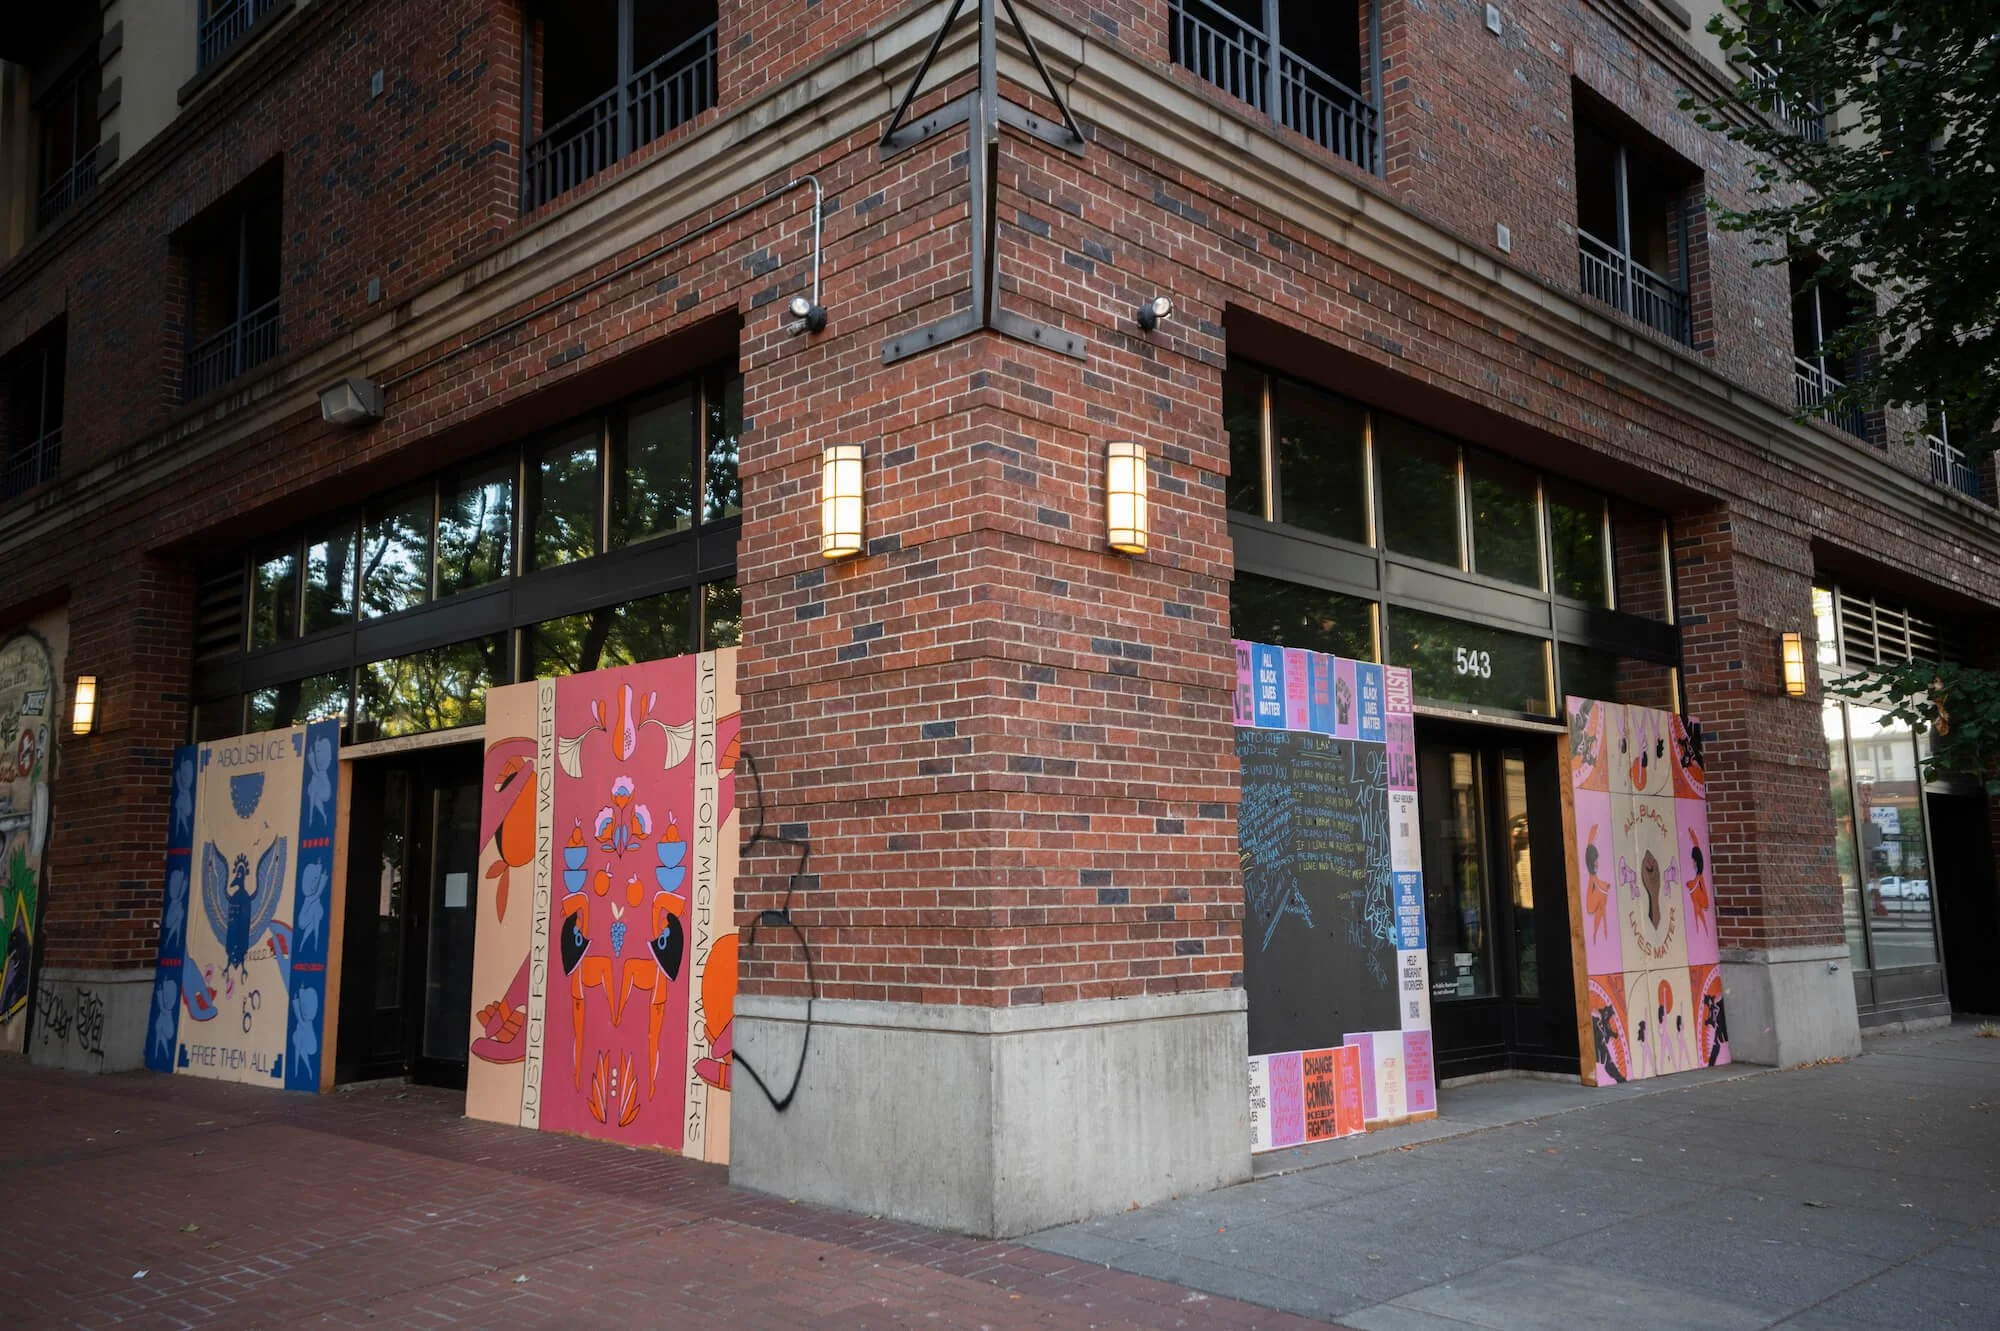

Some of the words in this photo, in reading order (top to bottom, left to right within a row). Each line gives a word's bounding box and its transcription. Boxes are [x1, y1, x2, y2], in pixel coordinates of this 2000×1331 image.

[1263, 653, 1273, 668] ALL
[1457, 647, 1492, 678] 543
[1260, 669, 1277, 684] BLACK
[1365, 671, 1375, 685] ALL
[1386, 665, 1410, 713] JUSTICE
[1262, 685, 1277, 700] LIVES
[1363, 687, 1378, 701] BLACK
[700, 659, 714, 777] JUSTICE
[1260, 701, 1281, 716] MATTER
[1362, 716, 1381, 730] MATTER
[1364, 702, 1377, 715] LIVES
[216, 744, 263, 768] ABOLISH
[263, 739, 286, 761] ICE
[538, 685, 554, 813] WORKERS
[1388, 752, 1415, 787] LIVE
[698, 786, 713, 846] FOR
[1639, 803, 1668, 838] BLACK
[535, 823, 551, 937] MIGRANT
[1628, 910, 1652, 956] LIVES
[1653, 906, 1677, 959] MATTER
[531, 944, 546, 998] FOR
[191, 1044, 217, 1067] FREE
[220, 1047, 246, 1070] THEM
[250, 1052, 269, 1073] ALL
[524, 1009, 544, 1120] JUSTICE
[688, 998, 708, 1143] WORERS
[1304, 1055, 1333, 1076] CHANGE
[1306, 1080, 1334, 1109] COMING
[1307, 1108, 1335, 1120] KEEP
[1307, 1119, 1336, 1137] FIGHTING
